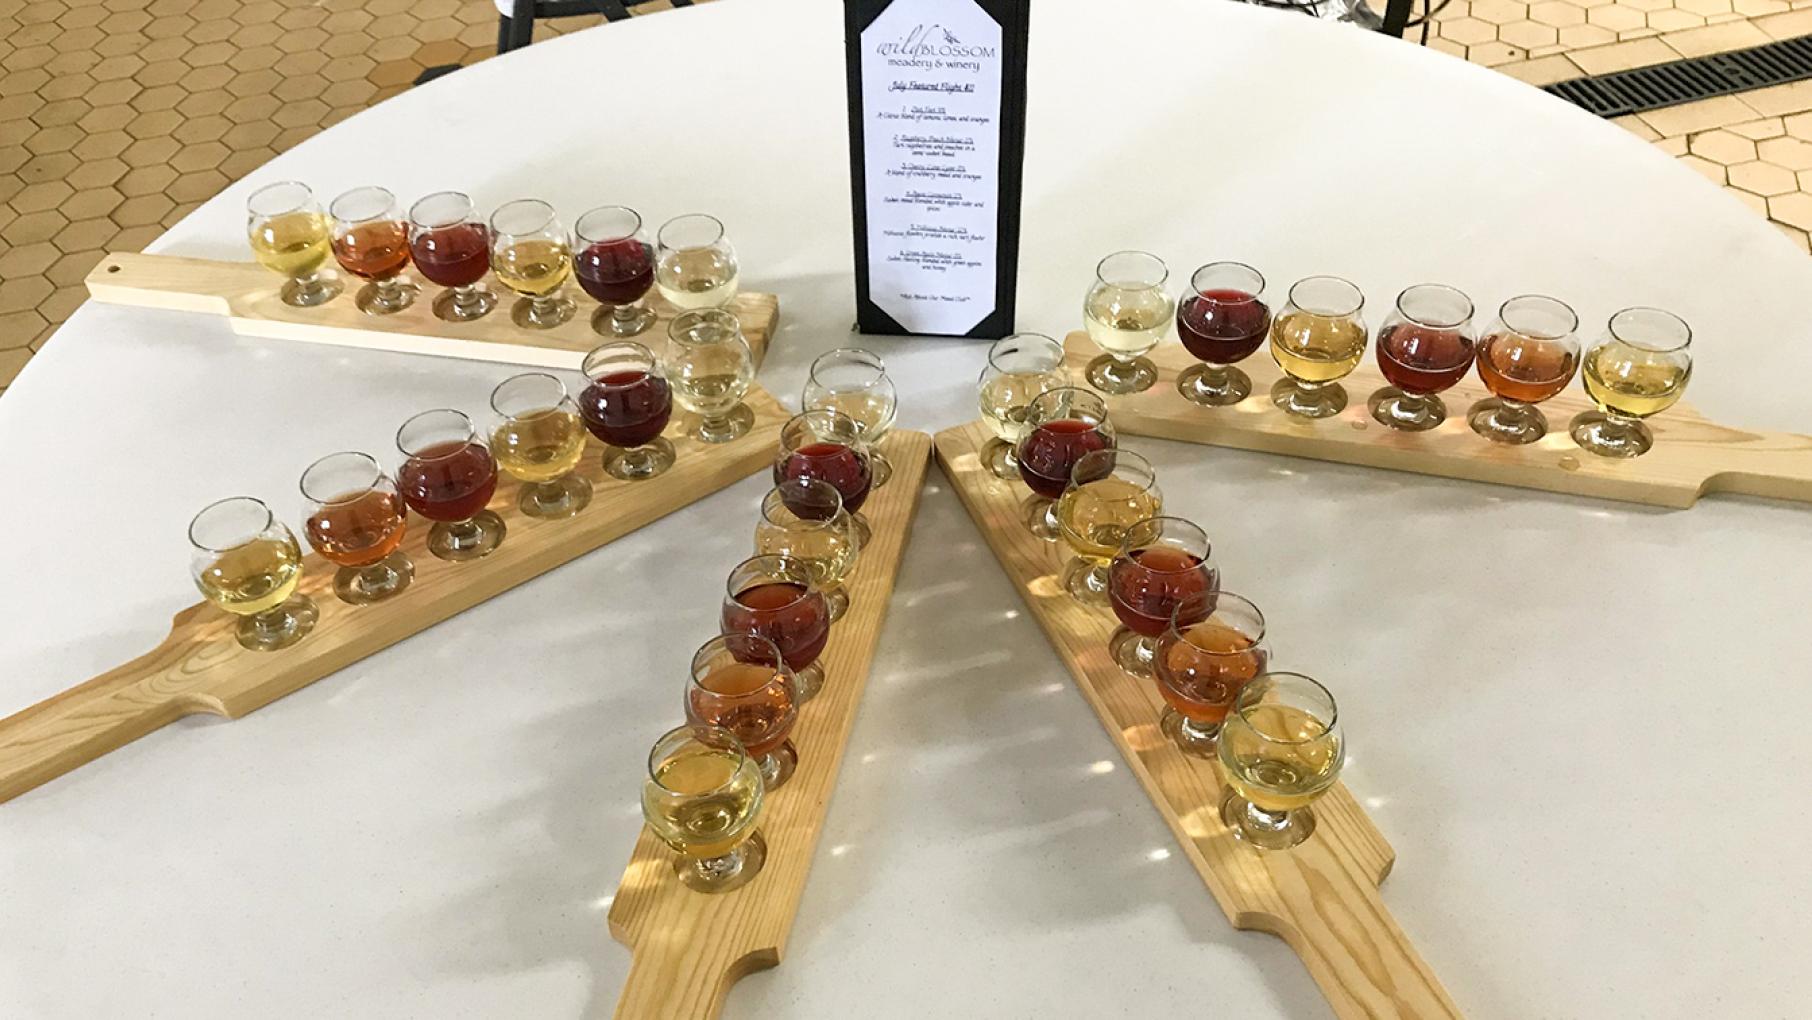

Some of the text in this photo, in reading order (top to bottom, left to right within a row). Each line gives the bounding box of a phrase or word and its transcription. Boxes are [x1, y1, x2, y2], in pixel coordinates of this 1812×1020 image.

[920, 44, 996, 58] BLOSSOM
[887, 58, 932, 72] meadery
[946, 61, 980, 73] winery
[888, 80, 908, 92] July
[909, 81, 939, 91] Featured
[941, 82, 962, 95] Flight
